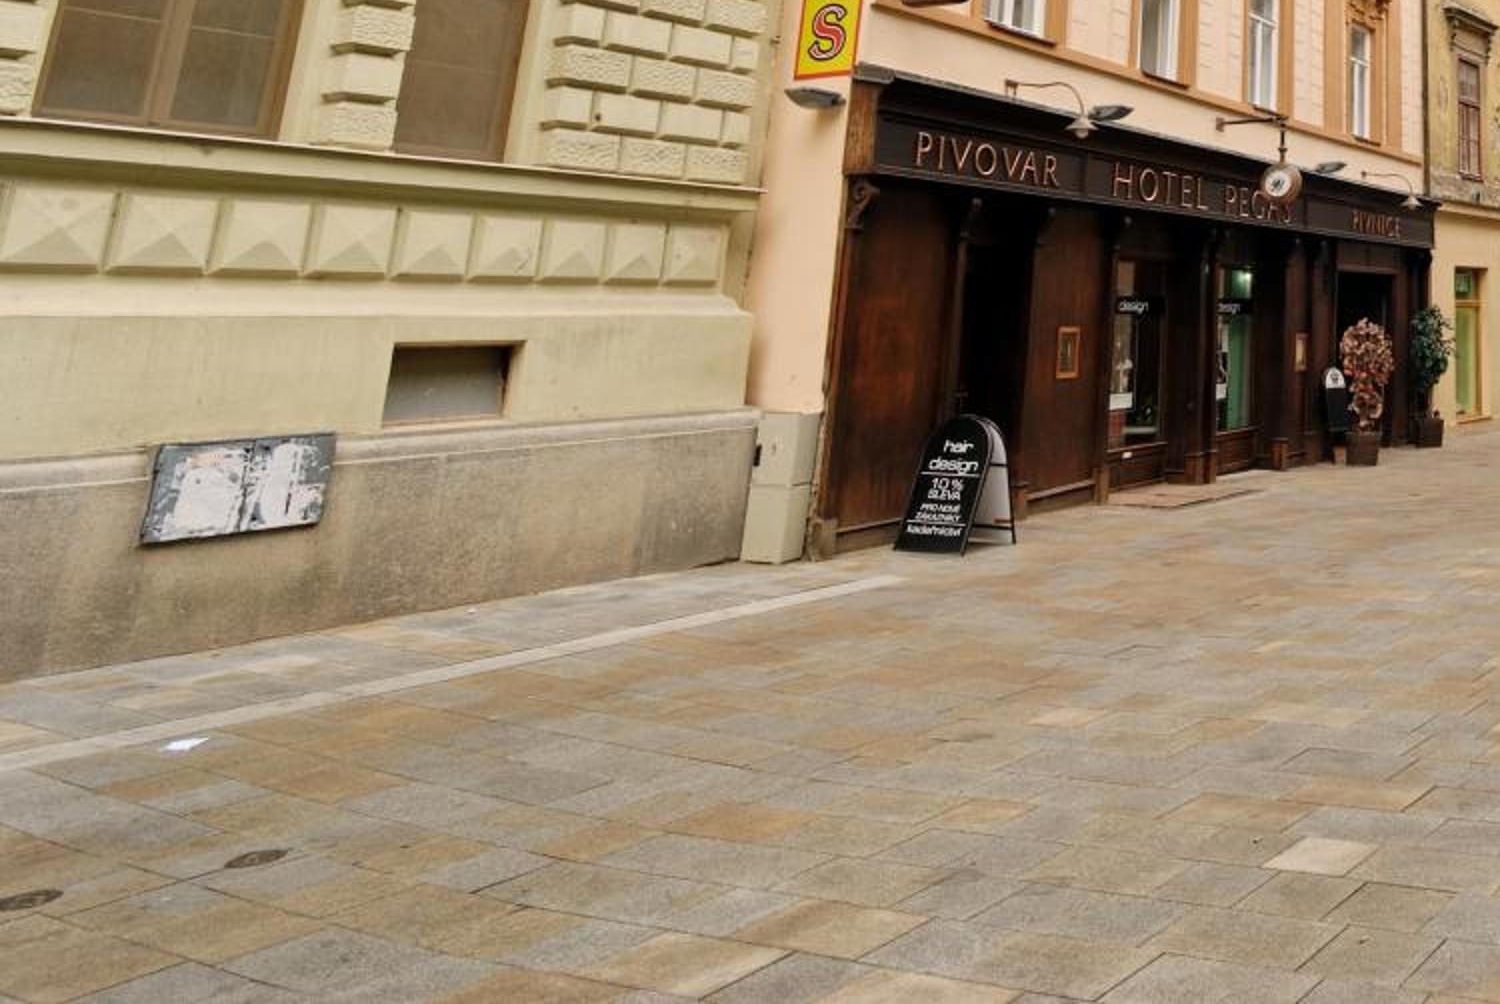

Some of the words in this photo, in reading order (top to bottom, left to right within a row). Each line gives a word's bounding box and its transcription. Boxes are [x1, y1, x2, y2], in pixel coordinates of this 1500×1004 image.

[914, 131, 1061, 188] PIVOVAR
[1112, 162, 1209, 211] HOTEL
[1223, 185, 1293, 224] PEGAS
[1119, 300, 1149, 314] design
[943, 439, 974, 453] hair
[928, 456, 979, 475] design
[927, 489, 961, 500] SLEVA
